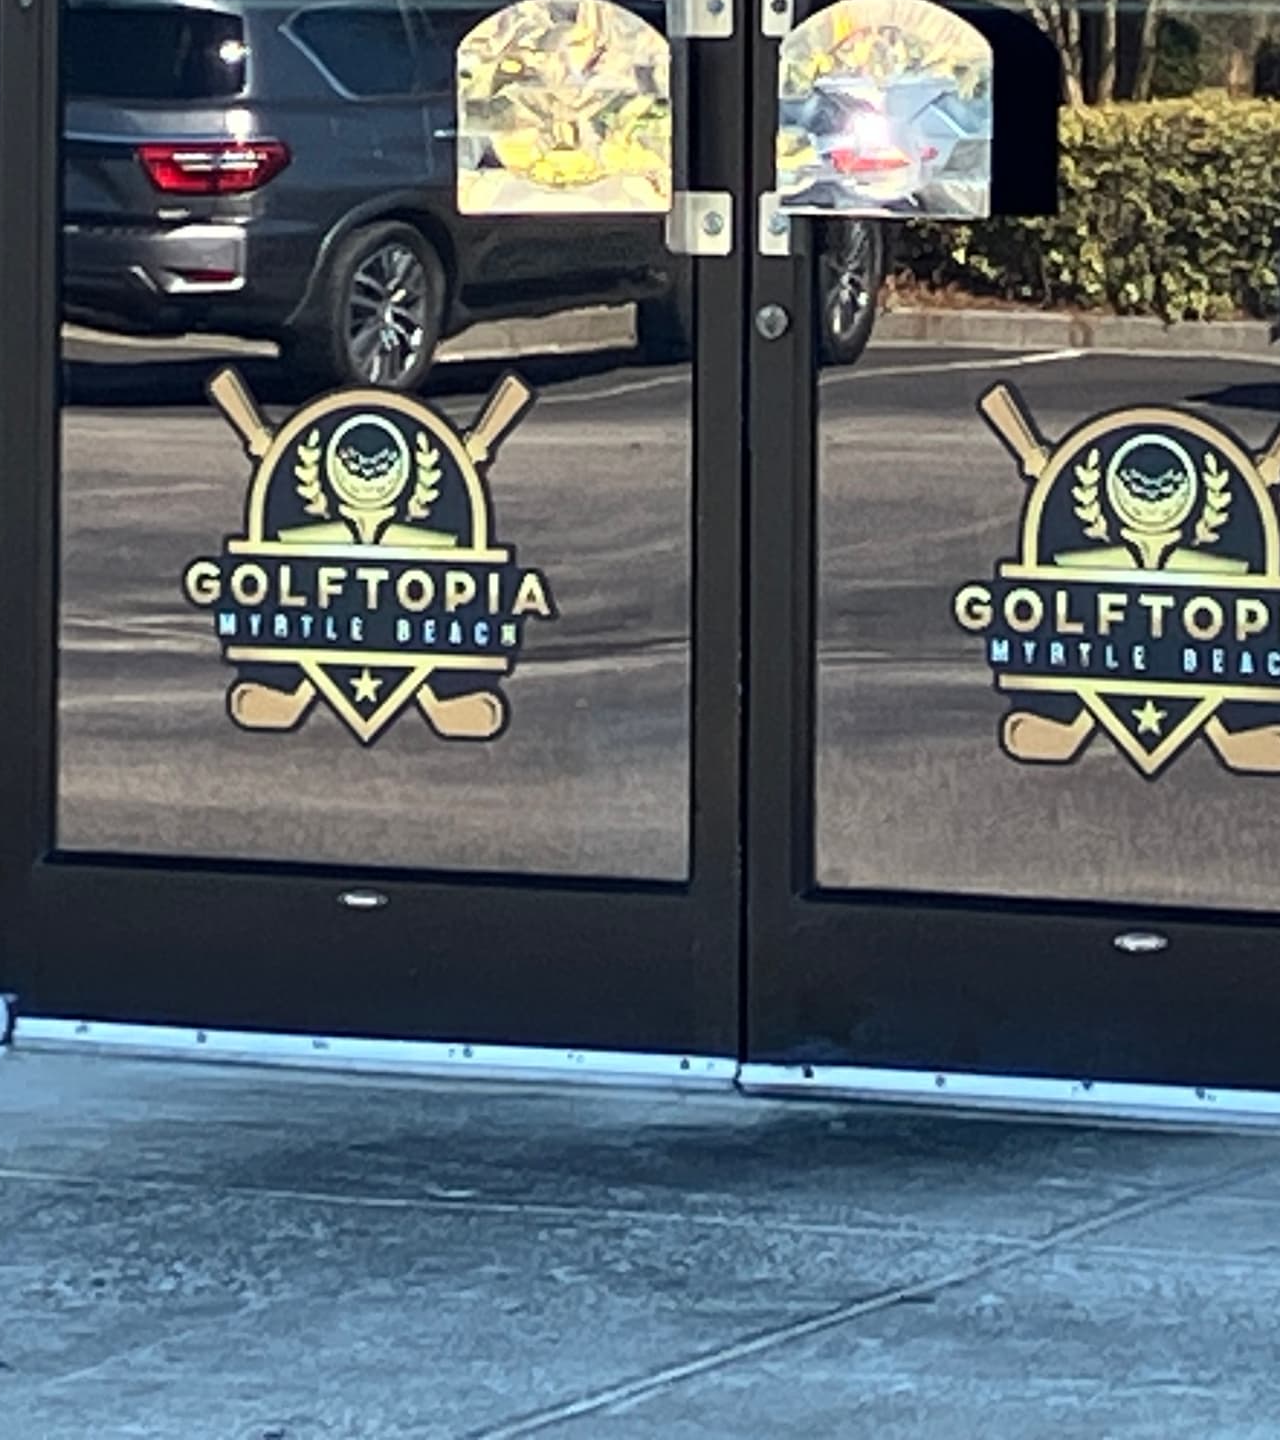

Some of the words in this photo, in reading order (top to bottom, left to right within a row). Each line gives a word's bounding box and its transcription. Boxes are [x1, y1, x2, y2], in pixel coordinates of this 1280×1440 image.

[184, 561, 552, 616] GOLFTOPIA
[219, 613, 365, 642] MYRTLE
[395, 618, 517, 646] BEACH
[991, 639, 1147, 672] MYRTLE
